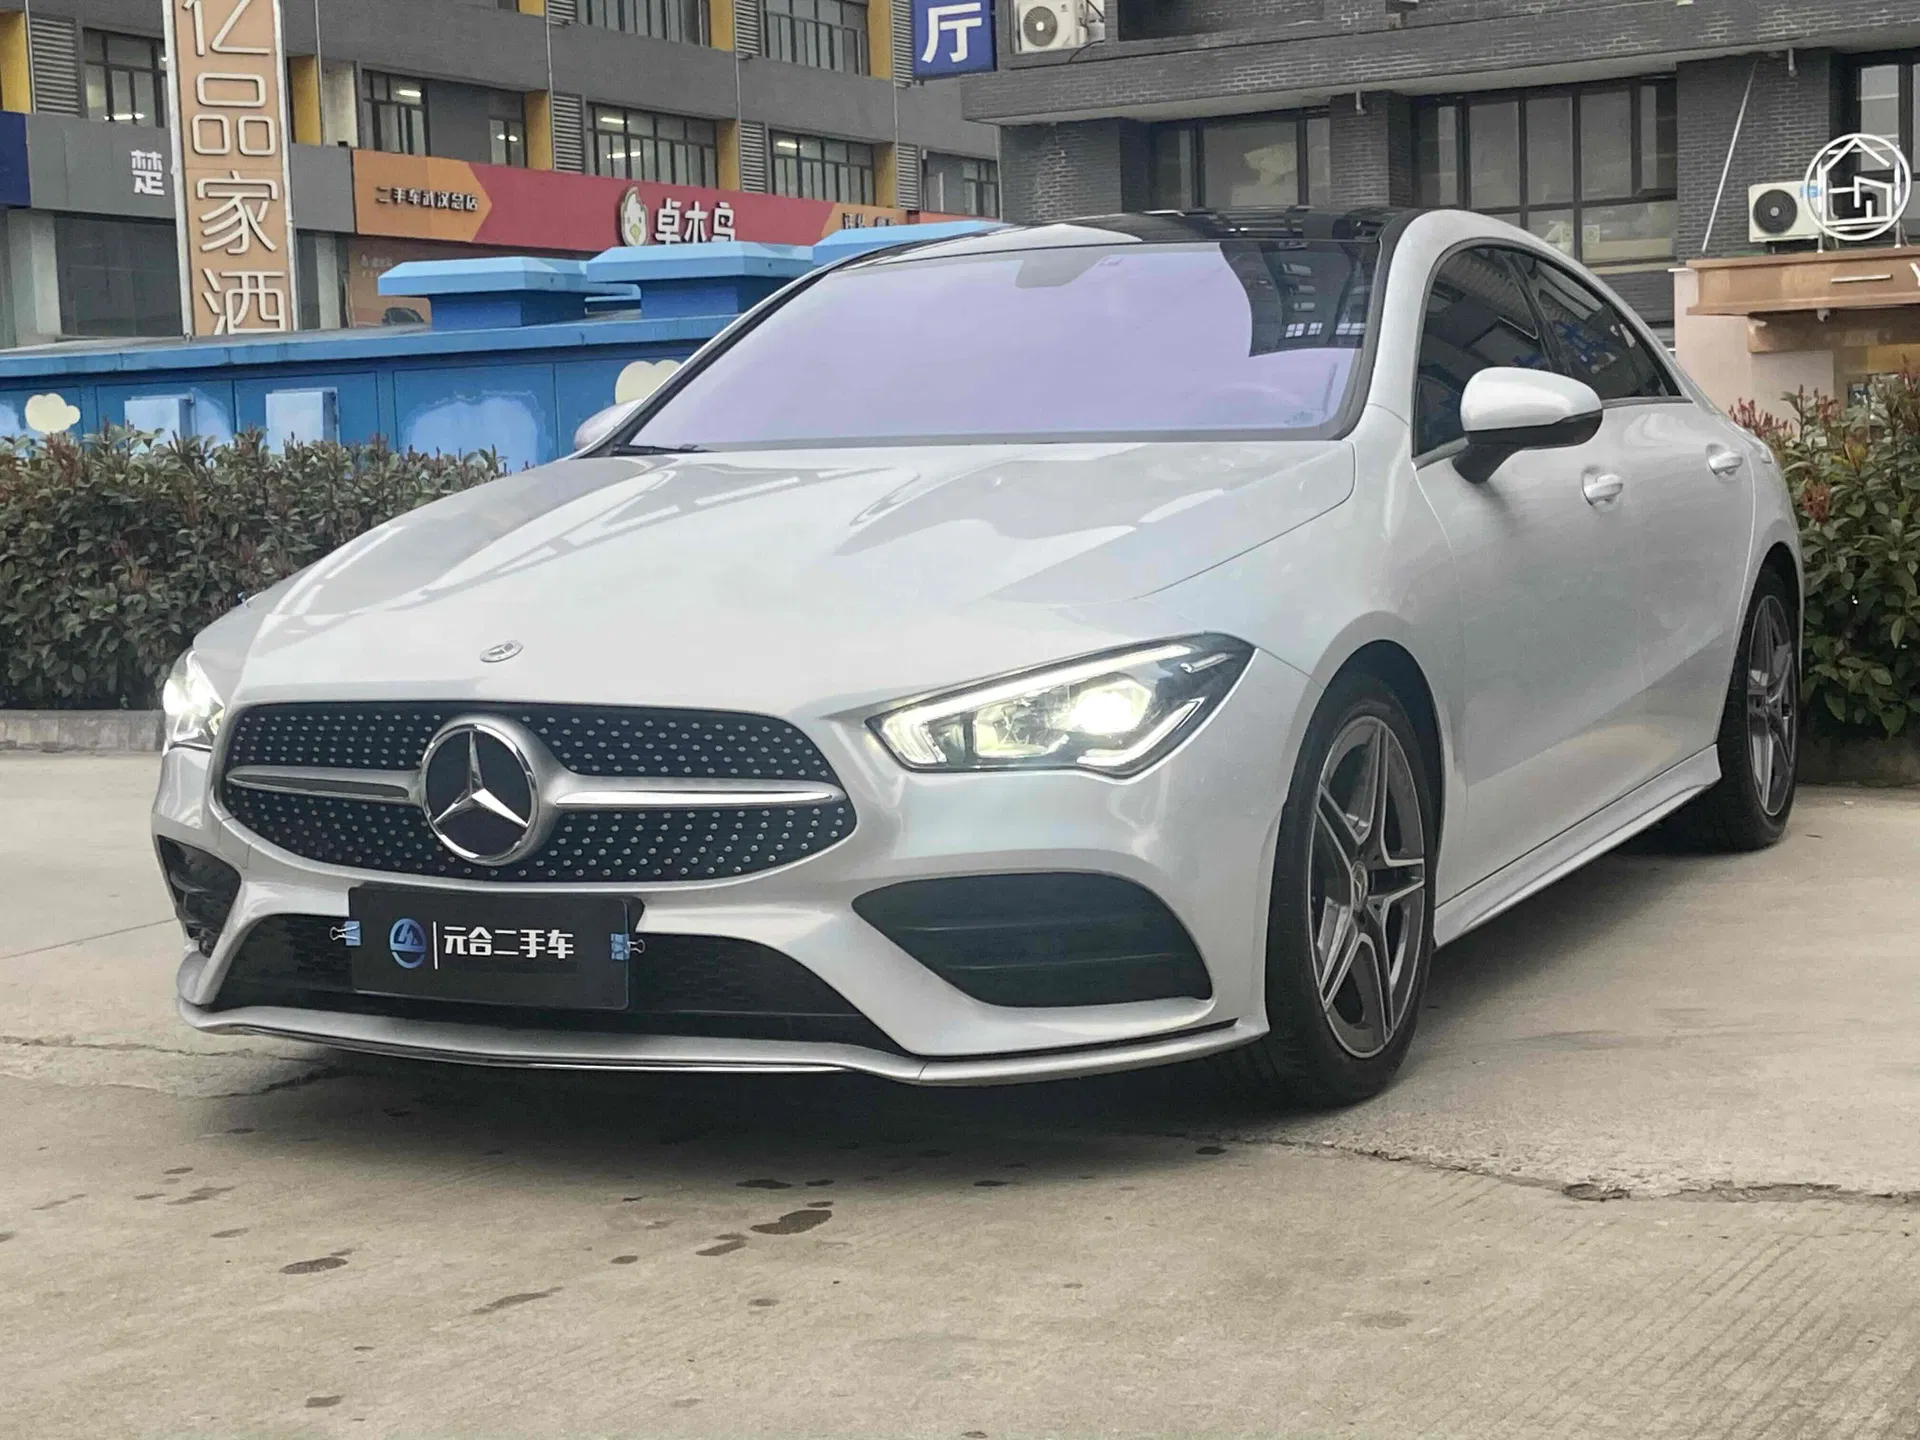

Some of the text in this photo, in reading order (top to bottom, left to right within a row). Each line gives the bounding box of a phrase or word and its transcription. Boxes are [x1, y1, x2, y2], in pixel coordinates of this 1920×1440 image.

[921, 2, 982, 63] 厅
[131, 149, 165, 195] 楚
[655, 197, 736, 244] 卓木鸟
[443, 926, 574, 959] 元合二手车
